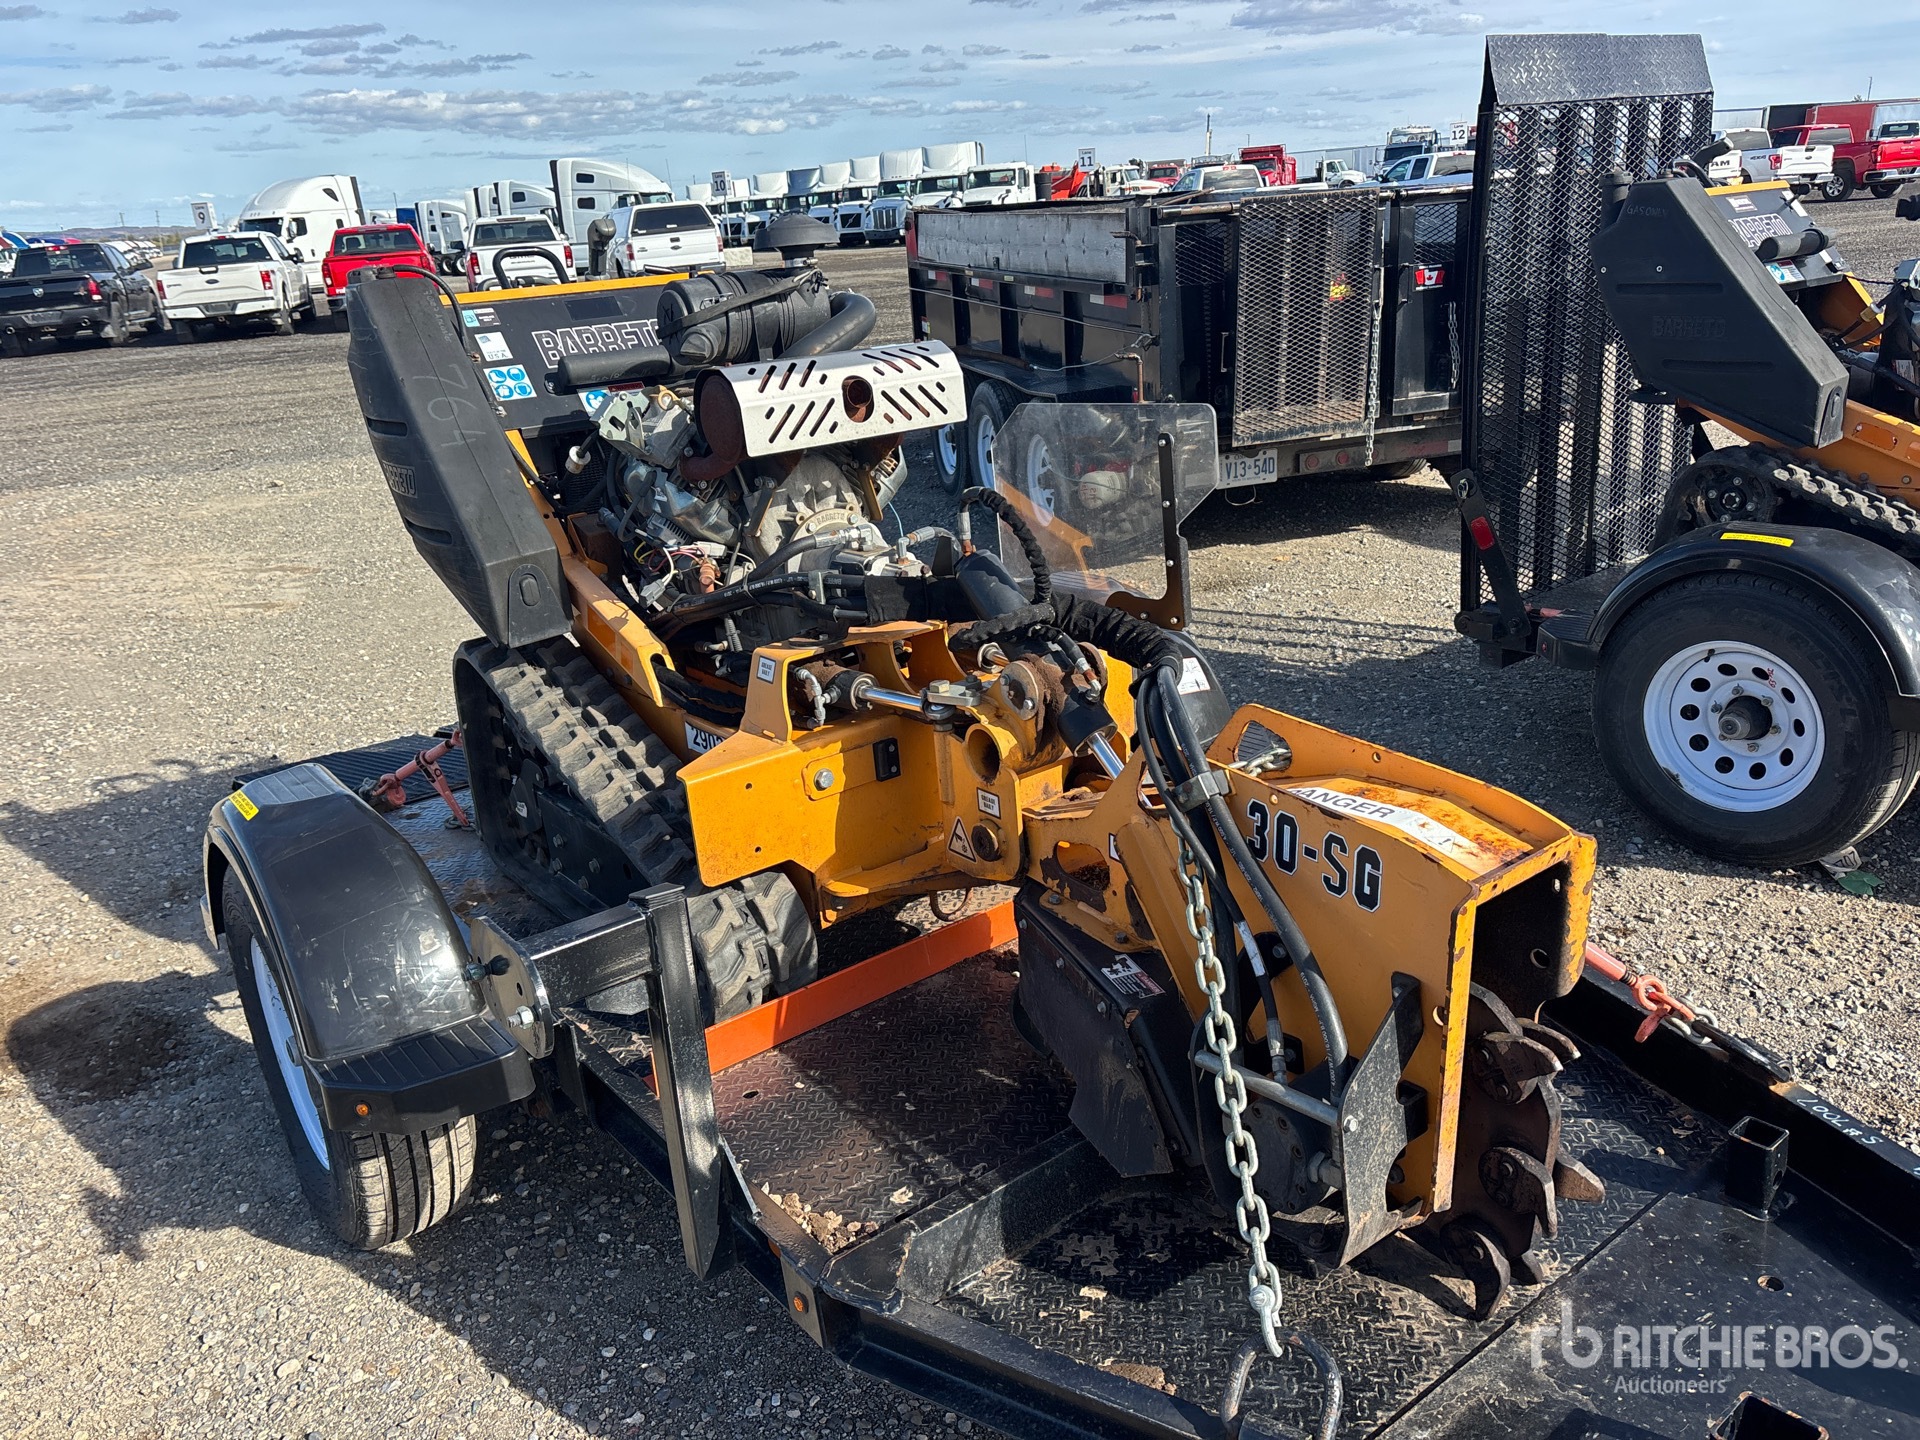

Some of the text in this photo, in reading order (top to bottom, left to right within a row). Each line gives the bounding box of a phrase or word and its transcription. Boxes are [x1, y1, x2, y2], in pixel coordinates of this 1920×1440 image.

[1451, 129, 1466, 140] 12
[1080, 156, 1094, 167] 11
[714, 180, 726, 191] 10
[198, 211, 206, 224] 9
[1246, 798, 1384, 914] 30-SG
